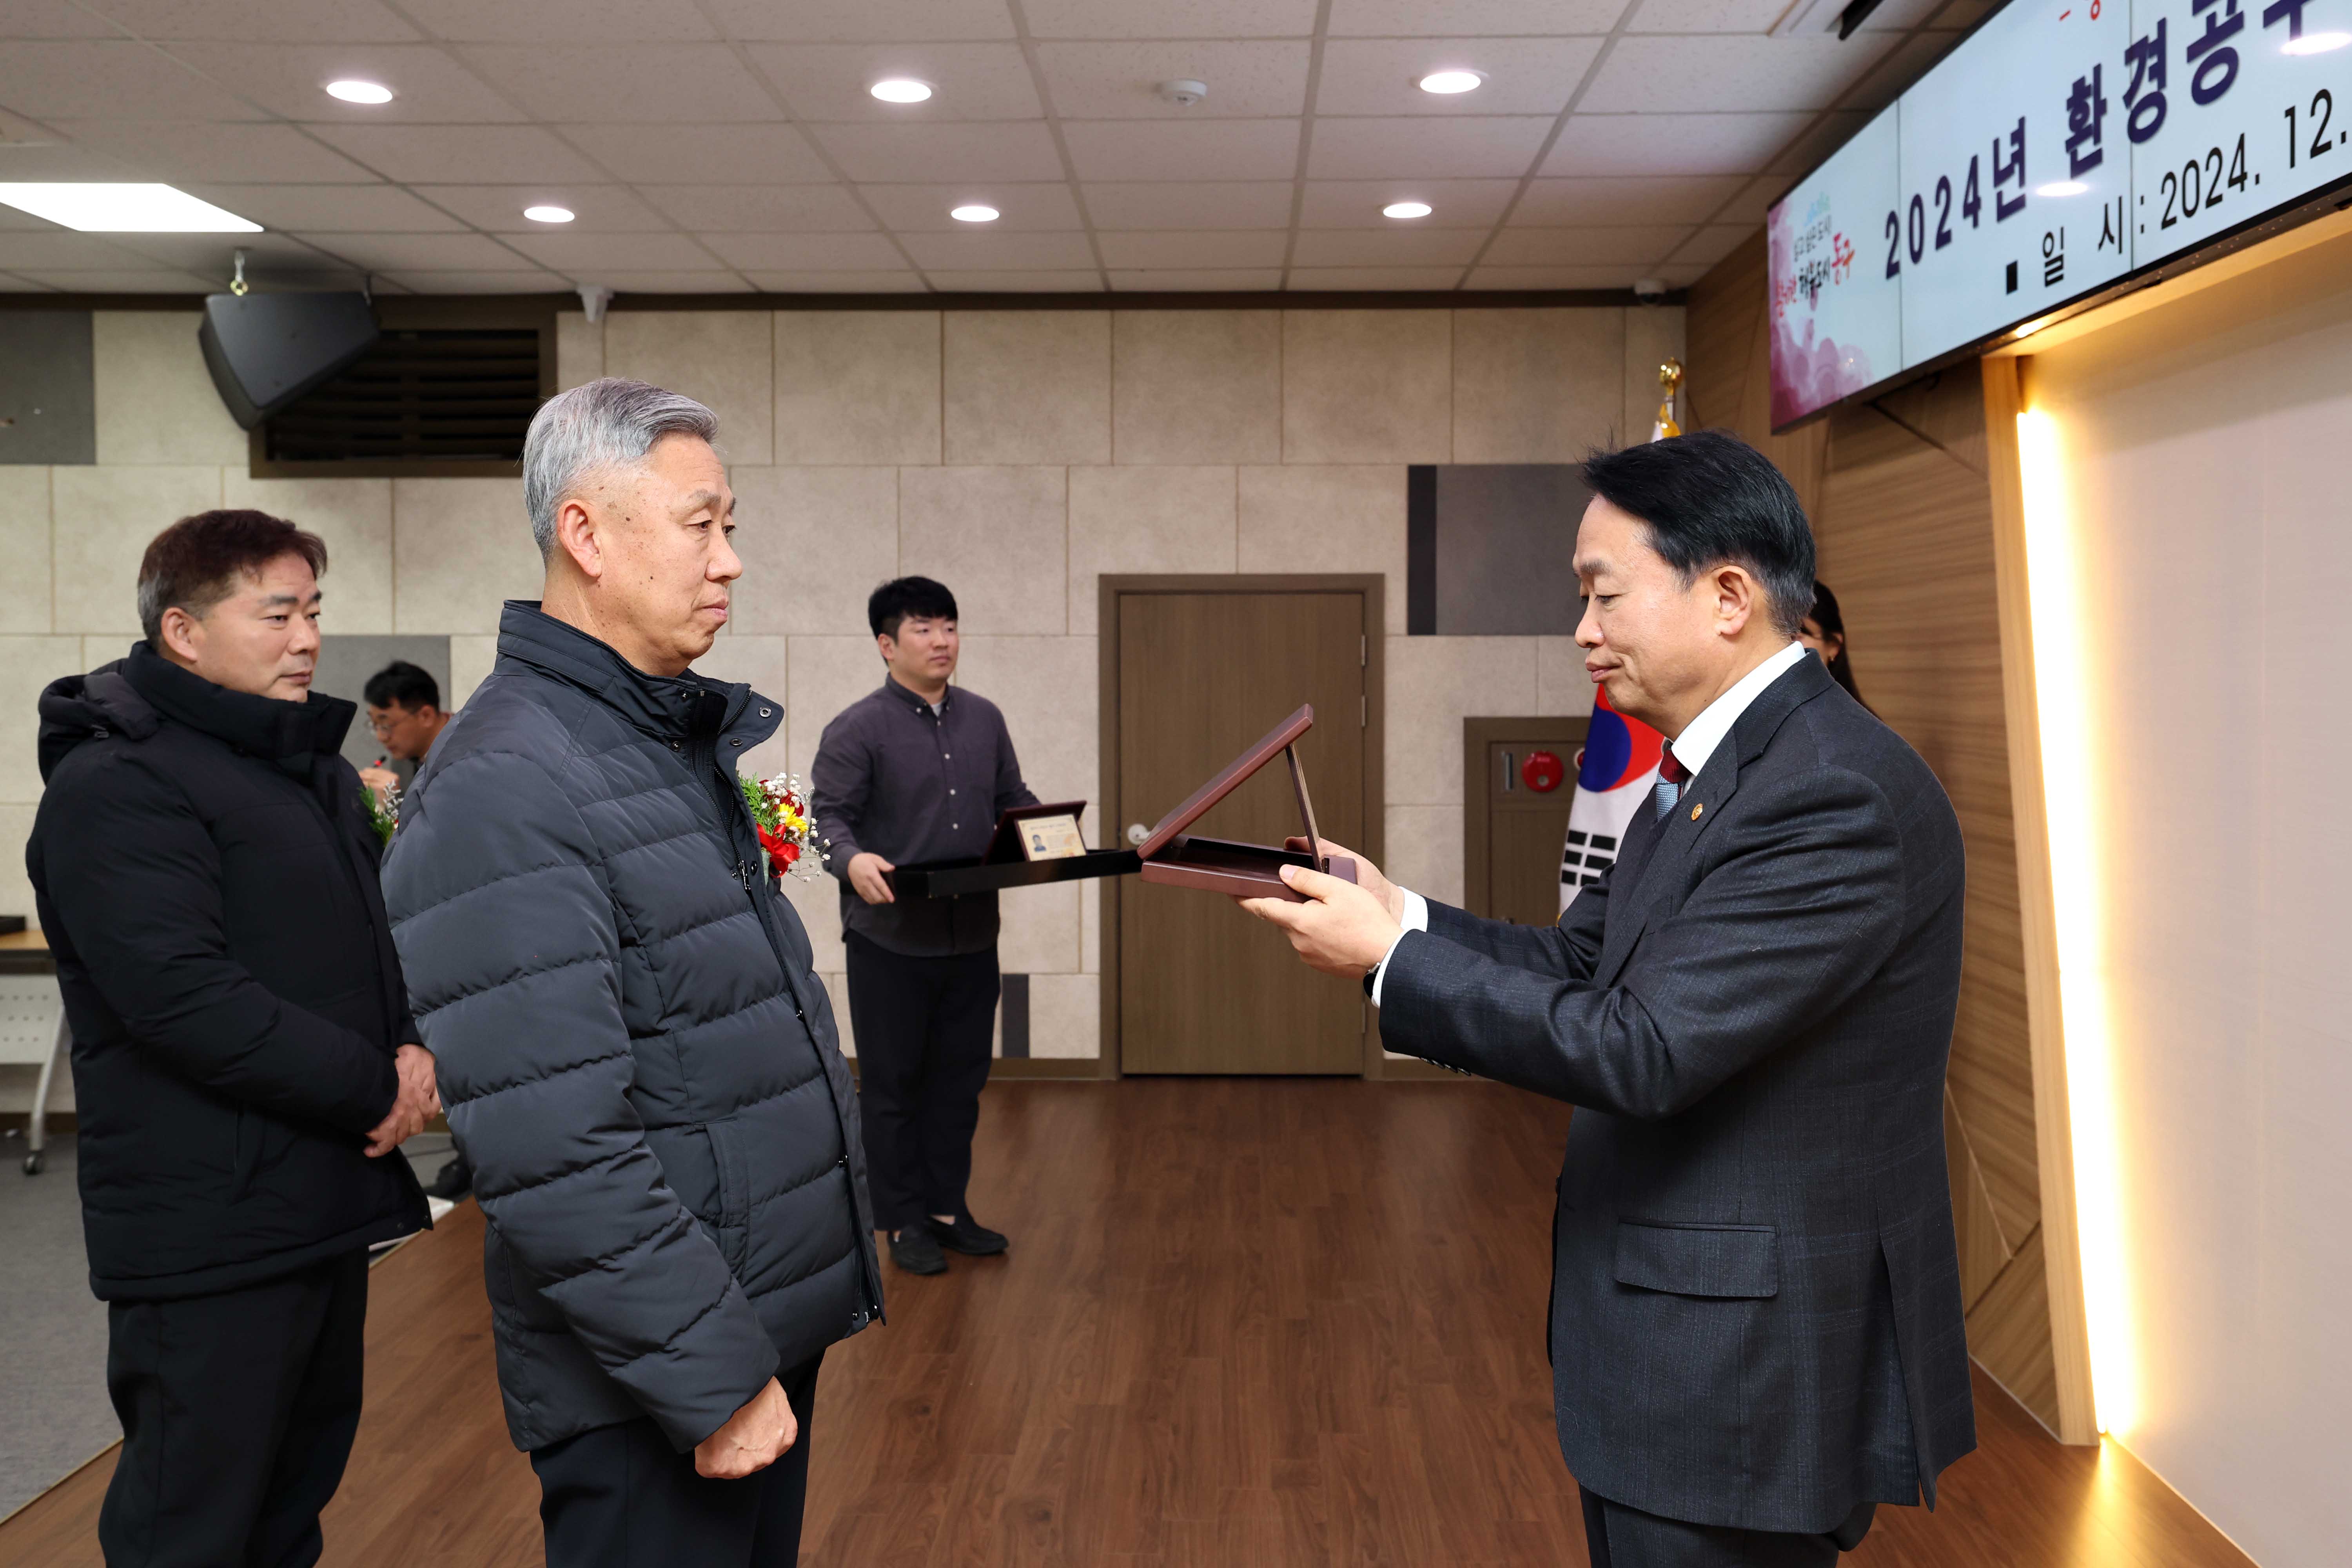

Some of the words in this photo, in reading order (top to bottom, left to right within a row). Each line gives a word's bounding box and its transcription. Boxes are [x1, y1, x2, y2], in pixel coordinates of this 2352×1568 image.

[1831, 232, 1855, 285] 동구
[1886, 115, 2025, 280] 2024년
[2043, 226, 2064, 287] 일
[2161, 132, 2260, 230] 2024.
[2284, 89, 2346, 169] 12.
